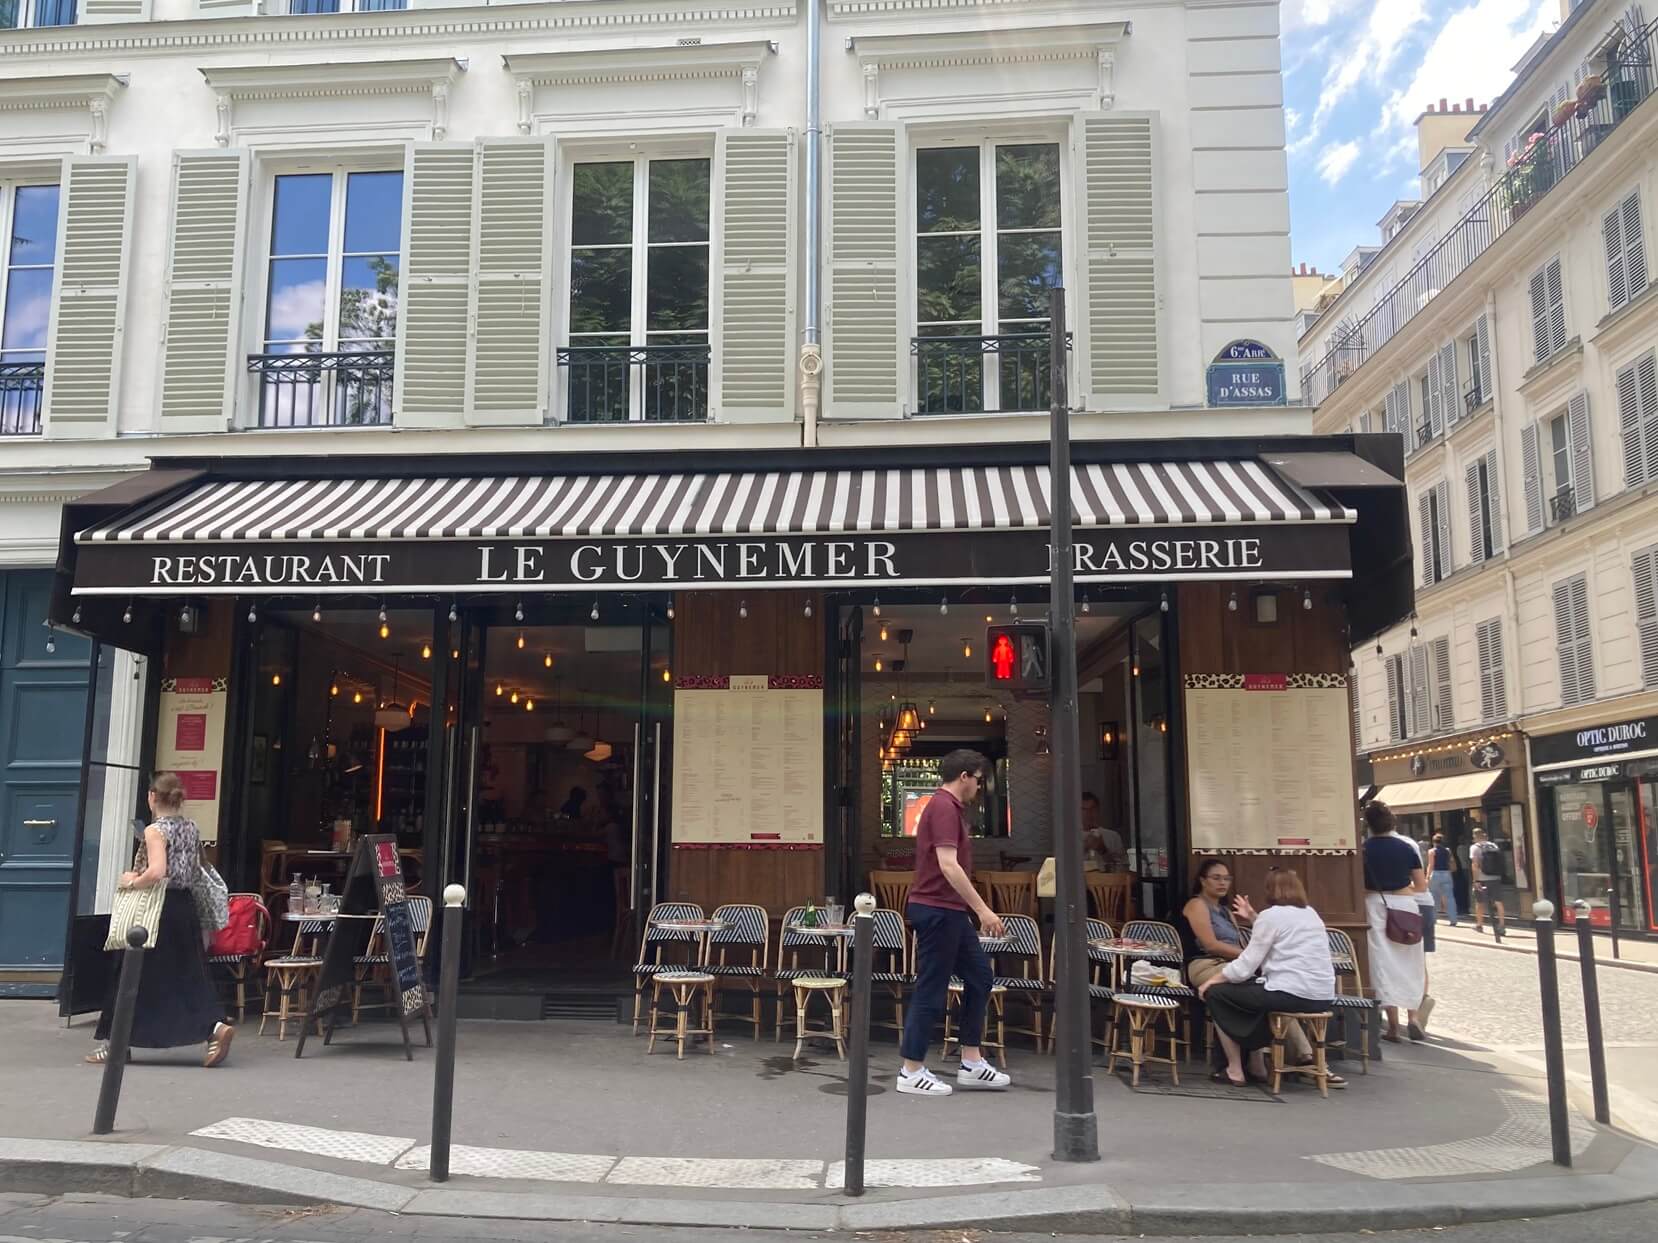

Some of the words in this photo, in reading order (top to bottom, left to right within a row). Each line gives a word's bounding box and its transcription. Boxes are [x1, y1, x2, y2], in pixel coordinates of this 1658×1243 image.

[1232, 373, 1260, 384] RUE
[1220, 386, 1272, 398] D'ASSAS
[150, 554, 391, 585] RESTAURANT
[476, 546, 545, 582] LE
[569, 541, 901, 582] GUYNEMER
[1577, 729, 1606, 747] OPTIC
[1608, 721, 1646, 742] DUROC
